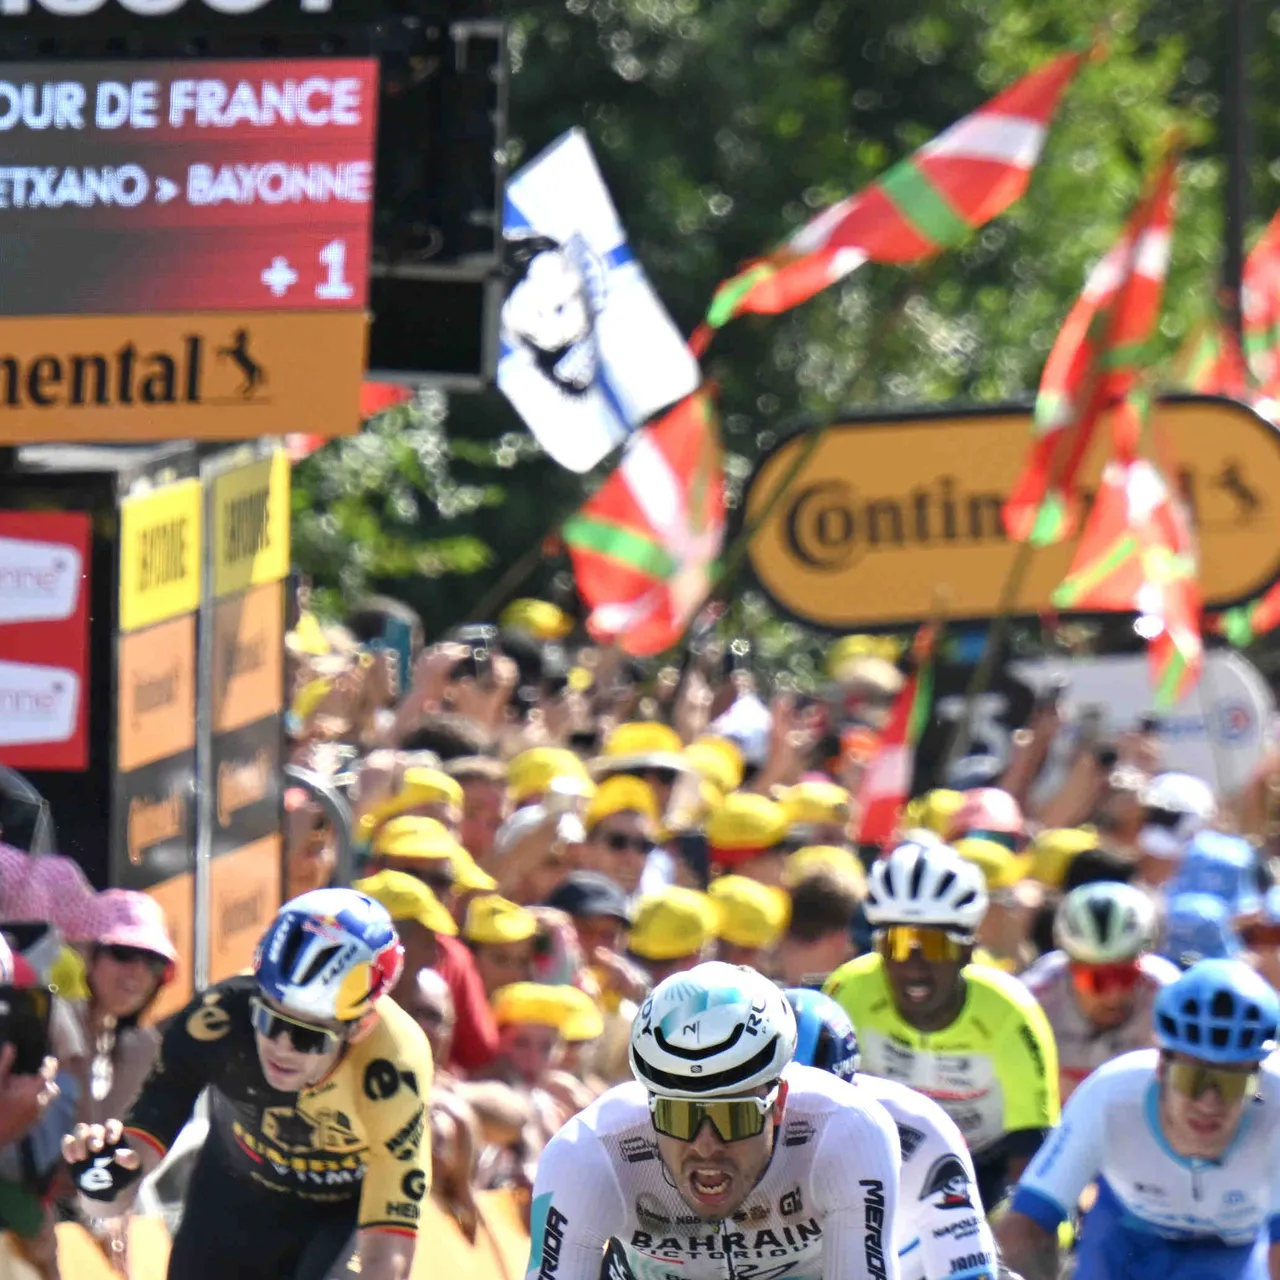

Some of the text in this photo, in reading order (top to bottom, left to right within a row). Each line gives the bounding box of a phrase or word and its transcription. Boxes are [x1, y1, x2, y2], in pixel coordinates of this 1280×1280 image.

[95, 79, 161, 130] DE
[169, 77, 361, 127] FRANCE
[187, 161, 372, 205] BAYONNE
[630, 1217, 823, 1252] BAHRAIN
